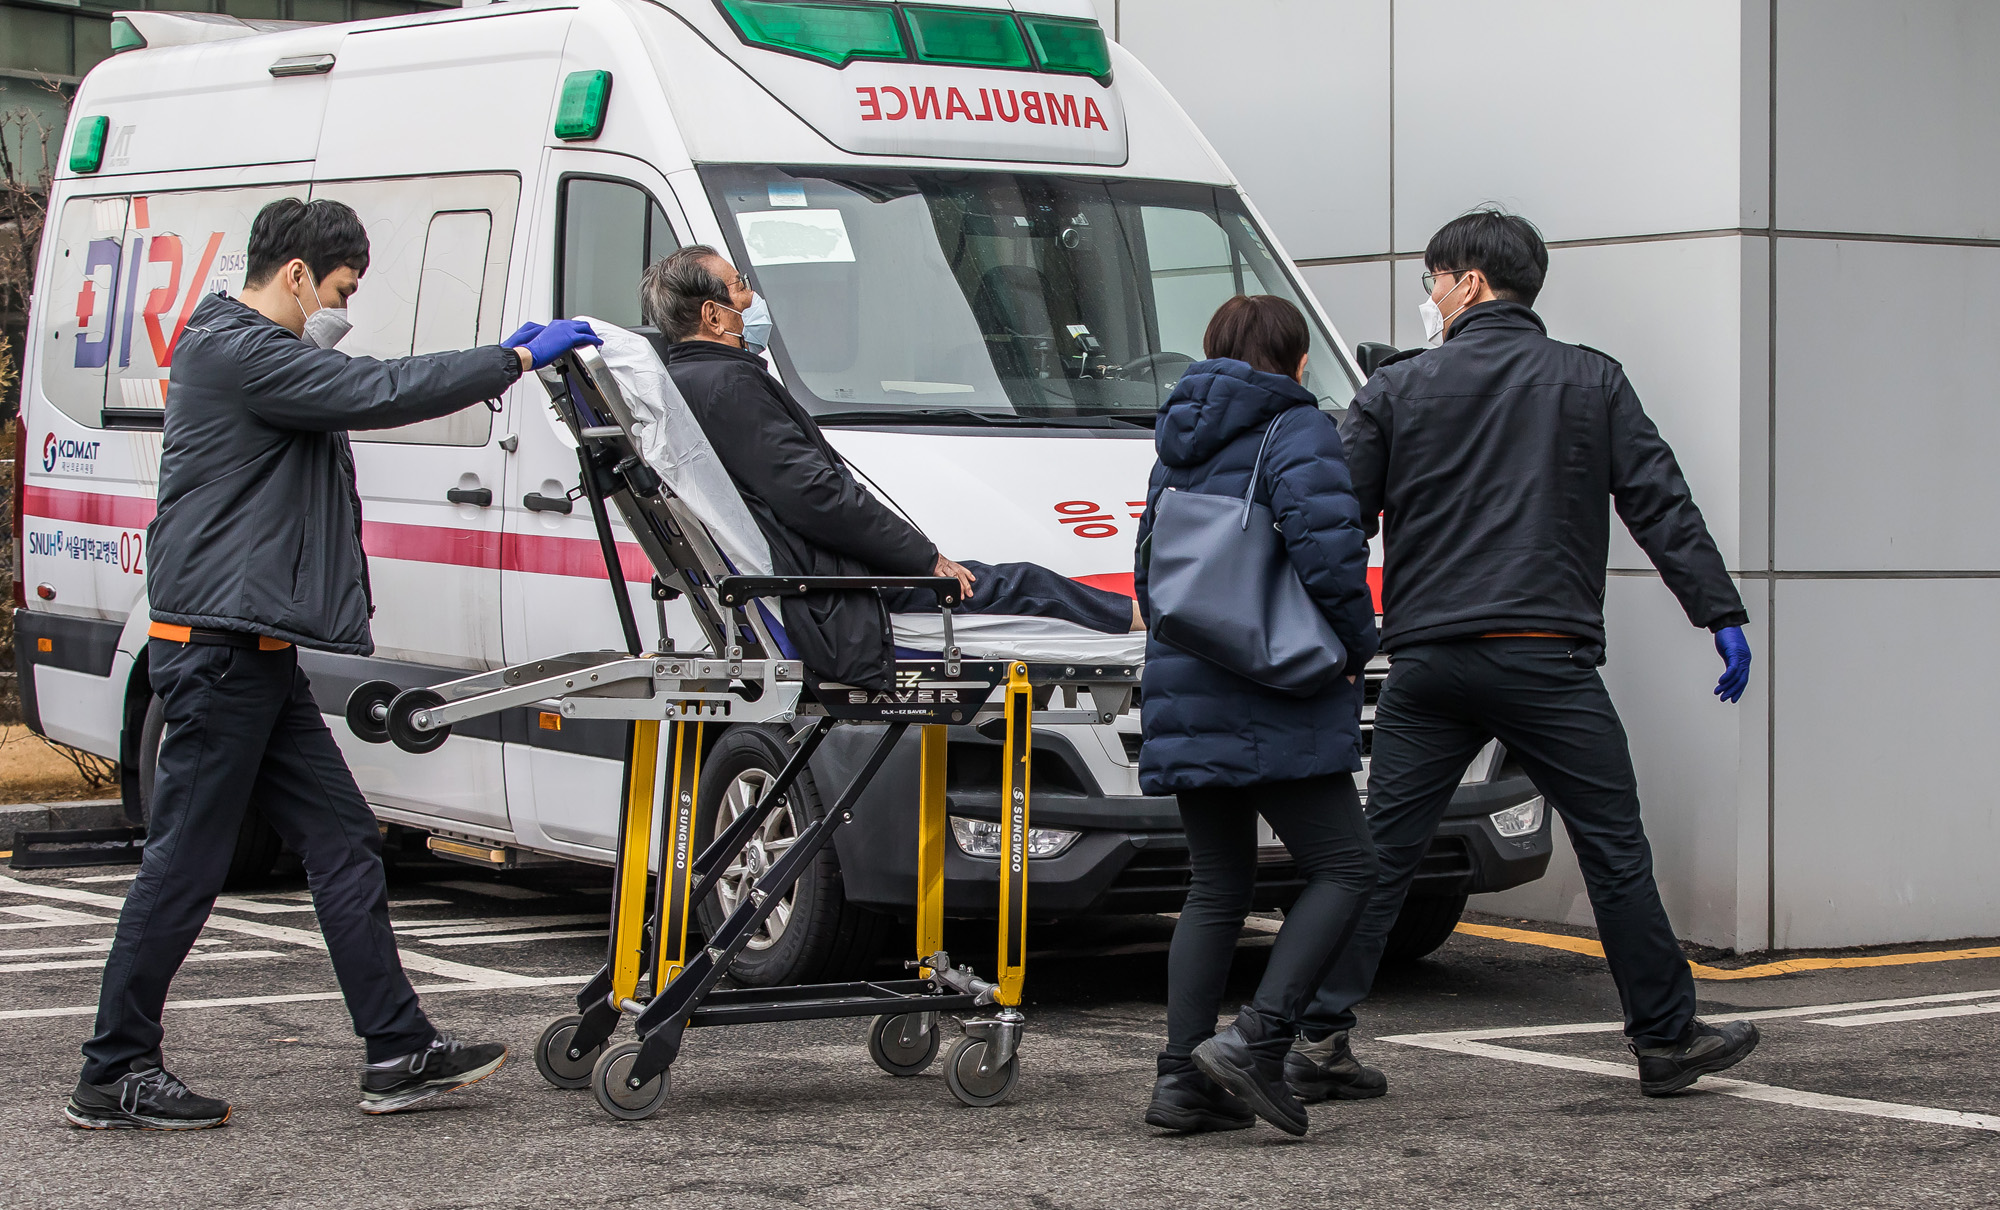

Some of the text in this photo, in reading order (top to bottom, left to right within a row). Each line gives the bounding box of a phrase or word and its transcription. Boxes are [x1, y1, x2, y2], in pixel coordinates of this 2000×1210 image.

[220, 254, 247, 271] DISAS
[58, 440, 100, 460] KDMAT
[29, 531, 119, 565] SNUH 서울대학교병원
[848, 690, 960, 704] SAVER
[676, 808, 689, 869] SUNGWOO
[1012, 806, 1023, 872] SUNGWOO
